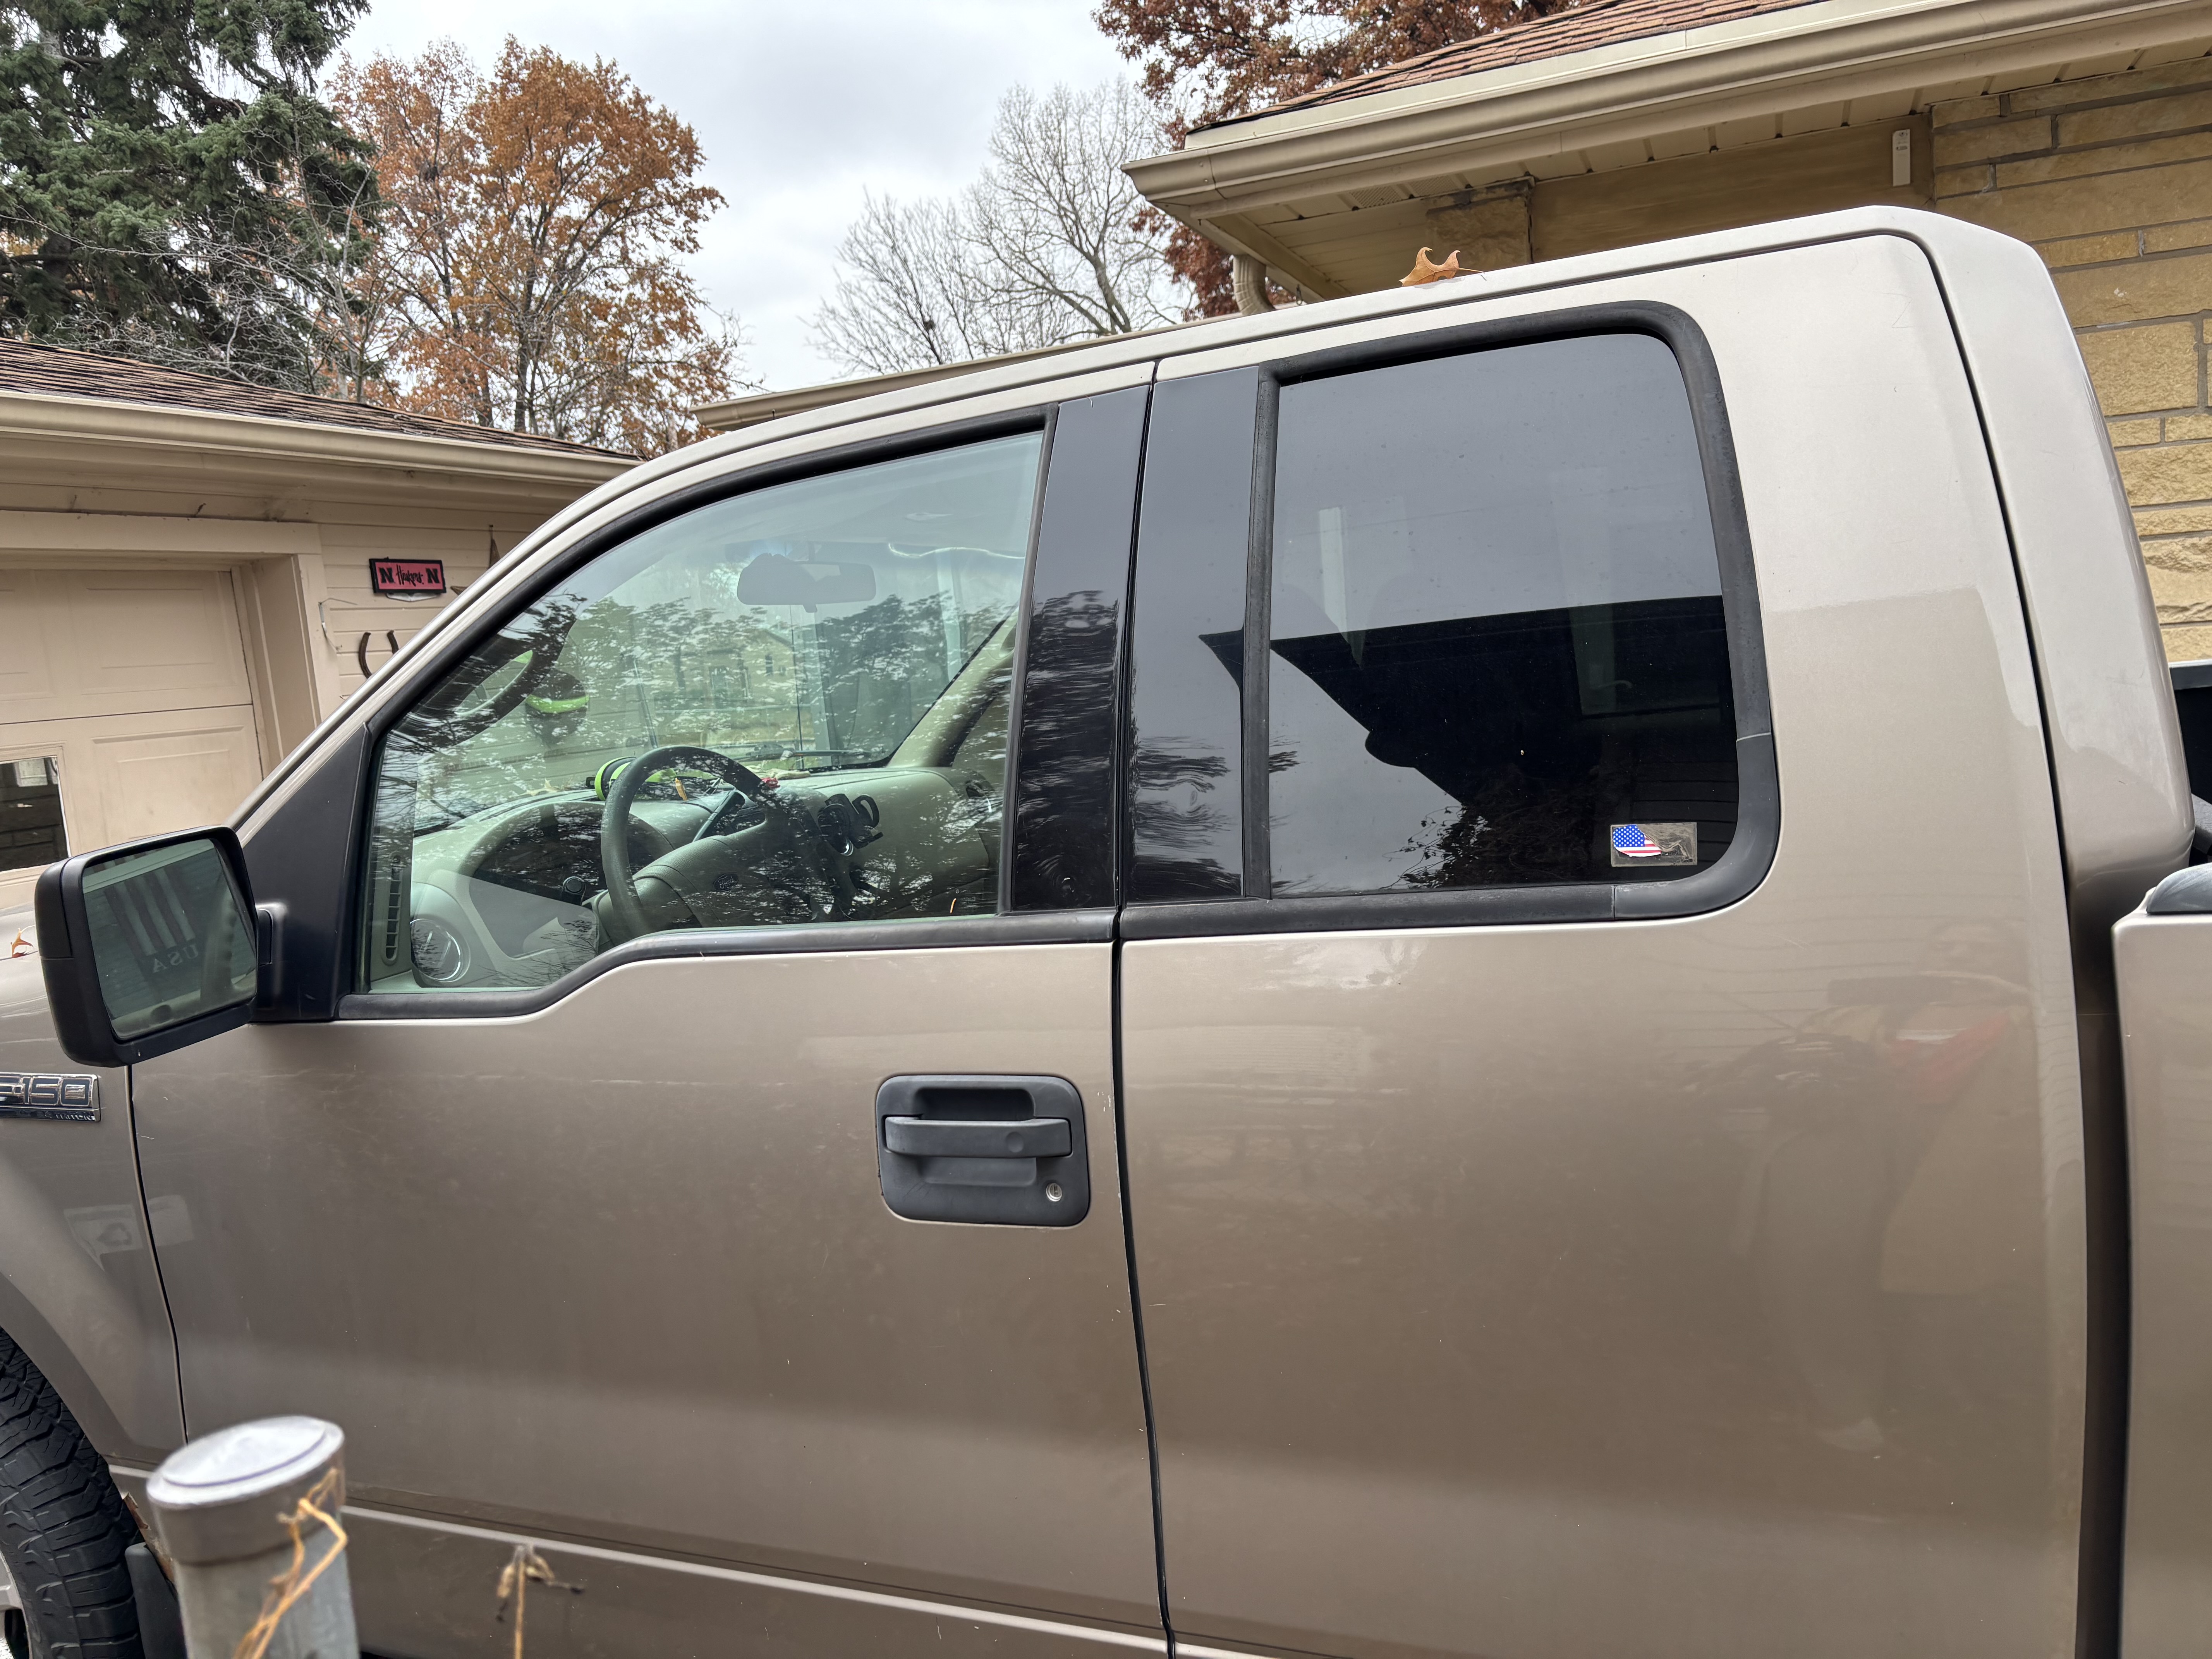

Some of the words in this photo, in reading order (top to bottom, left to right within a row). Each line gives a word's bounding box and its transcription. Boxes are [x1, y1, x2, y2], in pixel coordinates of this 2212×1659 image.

[378, 567, 395, 584] N
[396, 564, 423, 587] Huskers
[426, 568, 440, 584] N
